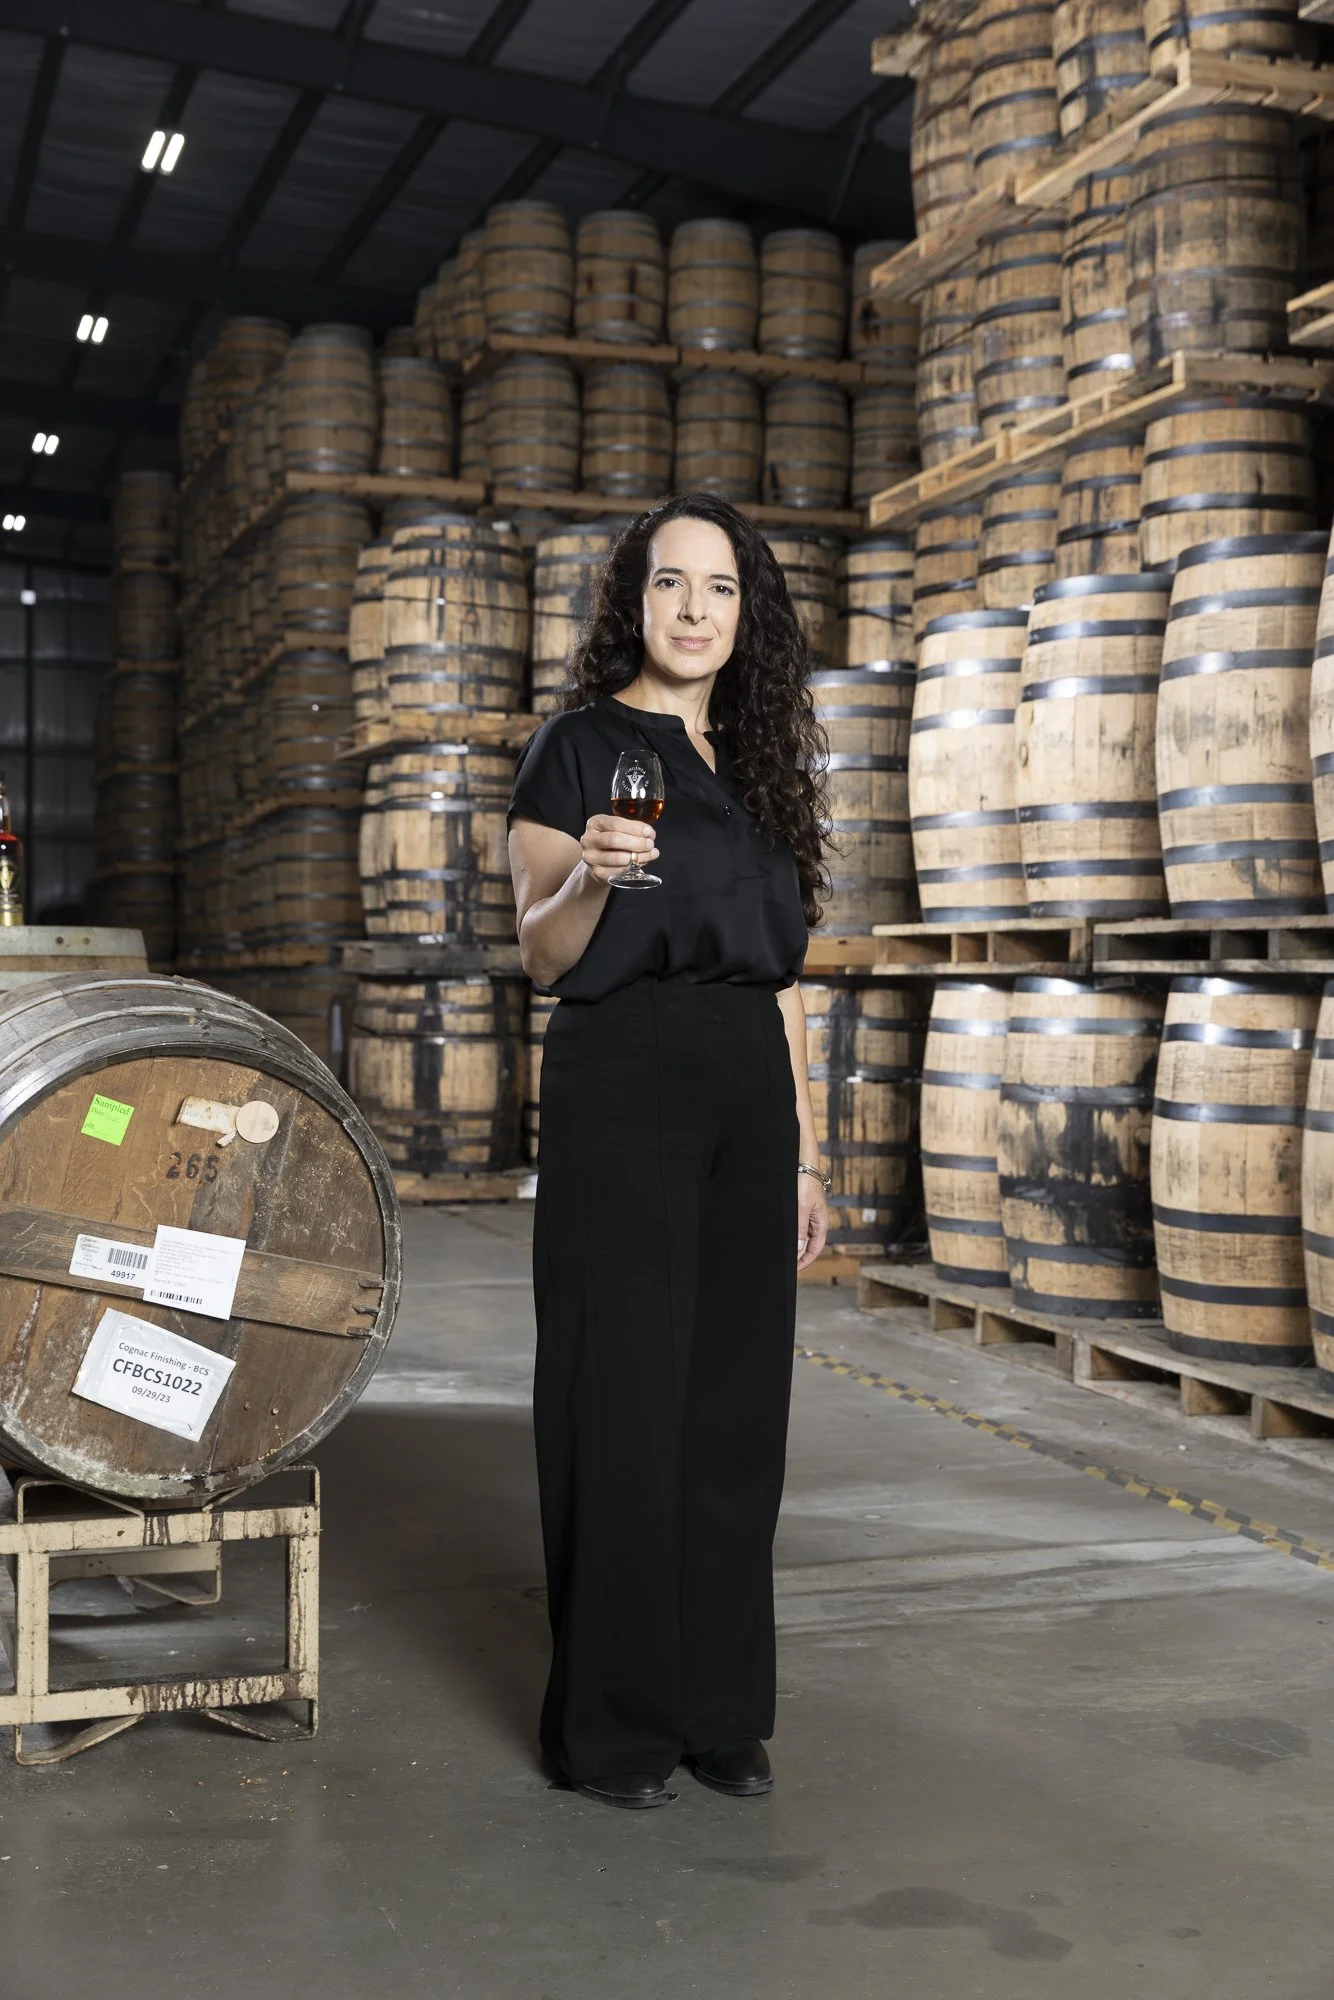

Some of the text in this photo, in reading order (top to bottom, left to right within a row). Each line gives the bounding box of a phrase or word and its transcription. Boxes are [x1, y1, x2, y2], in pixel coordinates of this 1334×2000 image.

[93, 1096, 131, 1116] Sampled
[166, 1151, 221, 1183] 265
[110, 1269, 136, 1281] 49917
[118, 1342, 149, 1358] Cognac
[150, 1351, 187, 1370] Finishing
[193, 1365, 210, 1376] BCS
[112, 1358, 203, 1396] CFBCS1022
[131, 1385, 171, 1403] 09/29/23
